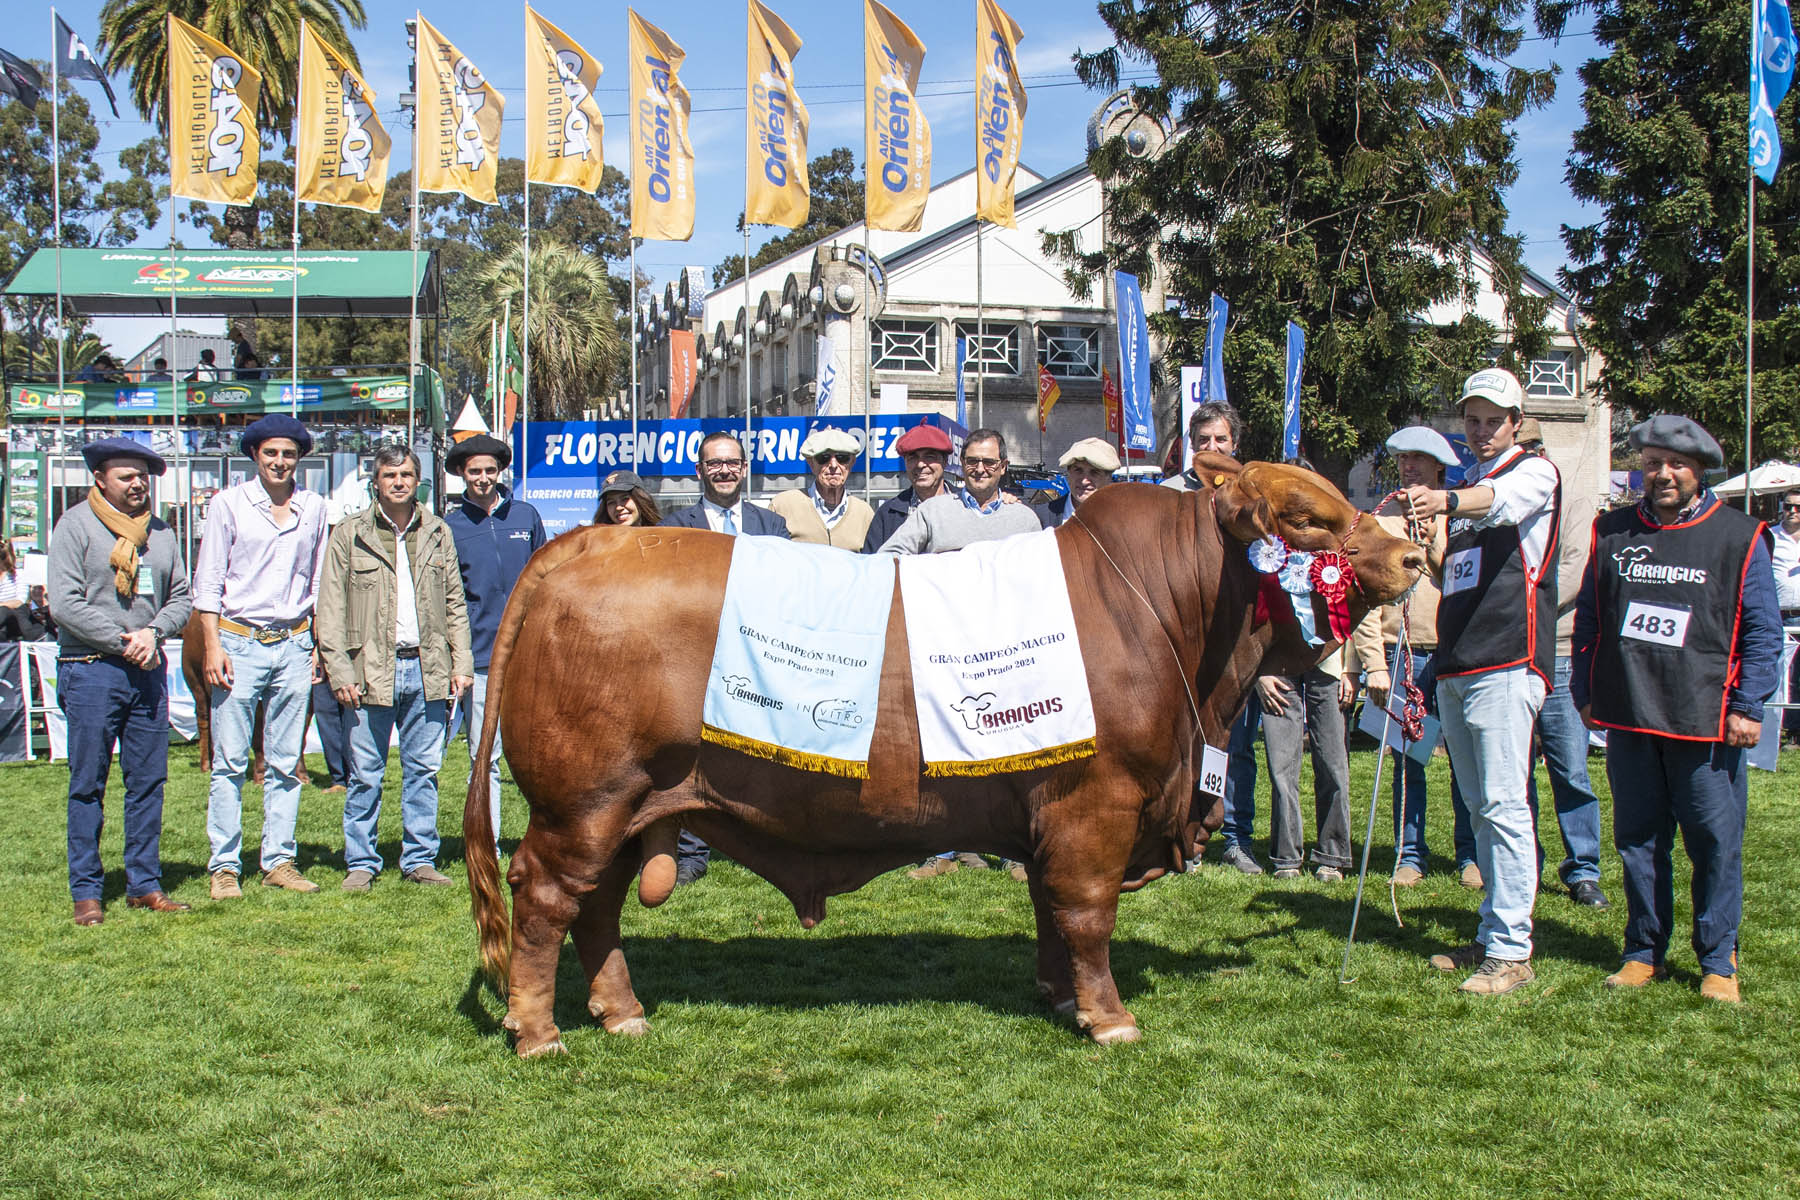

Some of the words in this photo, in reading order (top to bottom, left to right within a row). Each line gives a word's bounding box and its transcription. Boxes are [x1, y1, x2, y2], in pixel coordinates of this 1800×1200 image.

[640, 98, 654, 144] 770
[873, 86, 889, 132] 770
[648, 55, 671, 203] Oriental
[645, 144, 653, 169] AM
[879, 133, 889, 160] AM
[545, 430, 705, 466] FLORENCIO
[525, 489, 572, 499] LORENCIO
[1632, 563, 1707, 584] BRANGUS
[1630, 613, 1676, 637] 483
[739, 625, 768, 643] GRAN
[770, 638, 824, 660] CAMPEÓN
[827, 653, 867, 668] MACHO
[929, 654, 961, 664] GRAN
[964, 645, 1019, 664] CAMPEÓN
[1021, 632, 1065, 650] MACHO
[763, 651, 785, 664] Expo
[787, 659, 812, 673] Prado
[815, 667, 834, 677] 2024
[962, 671, 985, 681] Expo
[987, 664, 1013, 677] Prado
[1014, 656, 1035, 669] 2024
[737, 688, 783, 711] BRANGUS
[796, 703, 811, 713] IN
[820, 708, 863, 724] VITRO
[982, 697, 1063, 729] BRANGUS
[986, 723, 1025, 735] URUGUAY
[1204, 772, 1222, 793] 492
